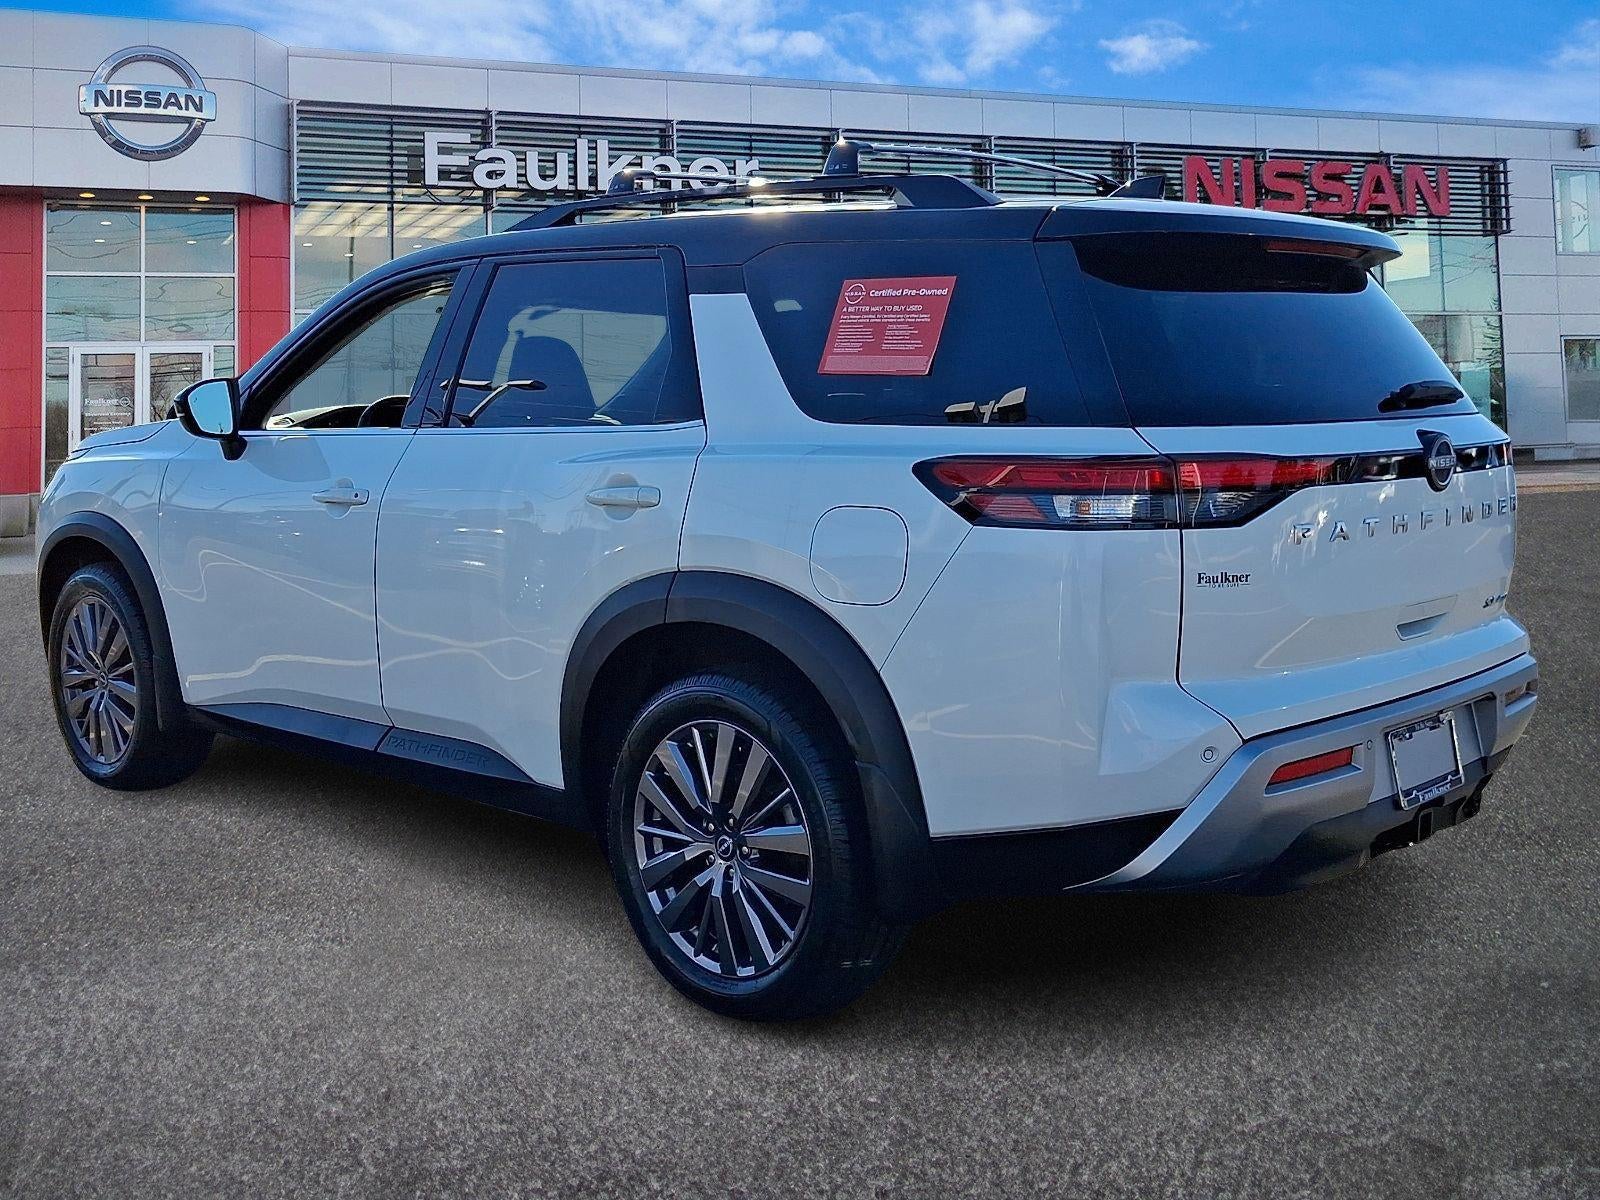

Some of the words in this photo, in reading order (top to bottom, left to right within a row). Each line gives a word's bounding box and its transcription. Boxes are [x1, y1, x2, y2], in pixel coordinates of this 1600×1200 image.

[93, 89, 204, 113] NISSAN
[423, 131, 760, 191] Faulkner
[1175, 155, 1451, 217] NISSAN
[869, 288, 902, 297] Certified
[903, 287, 949, 296] Pre-Owned
[848, 305, 870, 313] BETTER
[906, 304, 923, 312] USED
[1429, 457, 1456, 468] NISS
[1197, 572, 1251, 584] Faulkner
[386, 735, 489, 768] PATHFINDER
[1419, 782, 1452, 803] Faulkner
